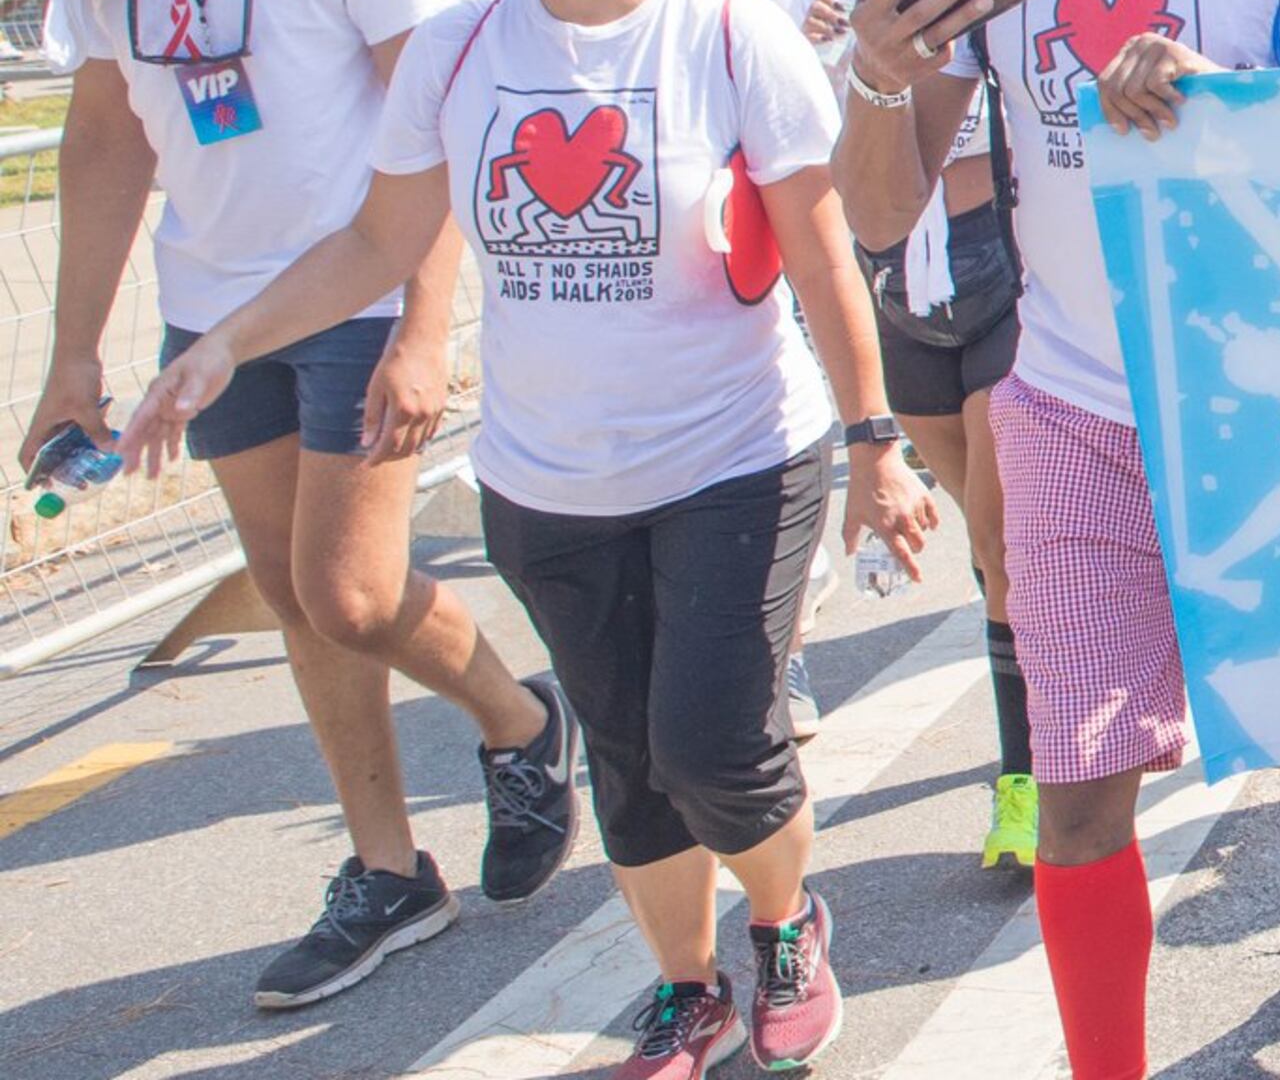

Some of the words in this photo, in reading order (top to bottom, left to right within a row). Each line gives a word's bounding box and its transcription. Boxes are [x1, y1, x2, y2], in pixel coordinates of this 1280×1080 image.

[187, 69, 239, 104] VIP
[1047, 131, 1069, 148] ALL
[1048, 150, 1084, 169] AIDS
[498, 260, 526, 277] ALL
[533, 262, 543, 278] T
[552, 263, 576, 279] NO
[584, 261, 653, 279] SHAIDS
[500, 278, 541, 301] AIDS
[552, 281, 613, 302] WALK
[615, 287, 654, 302] 2019
